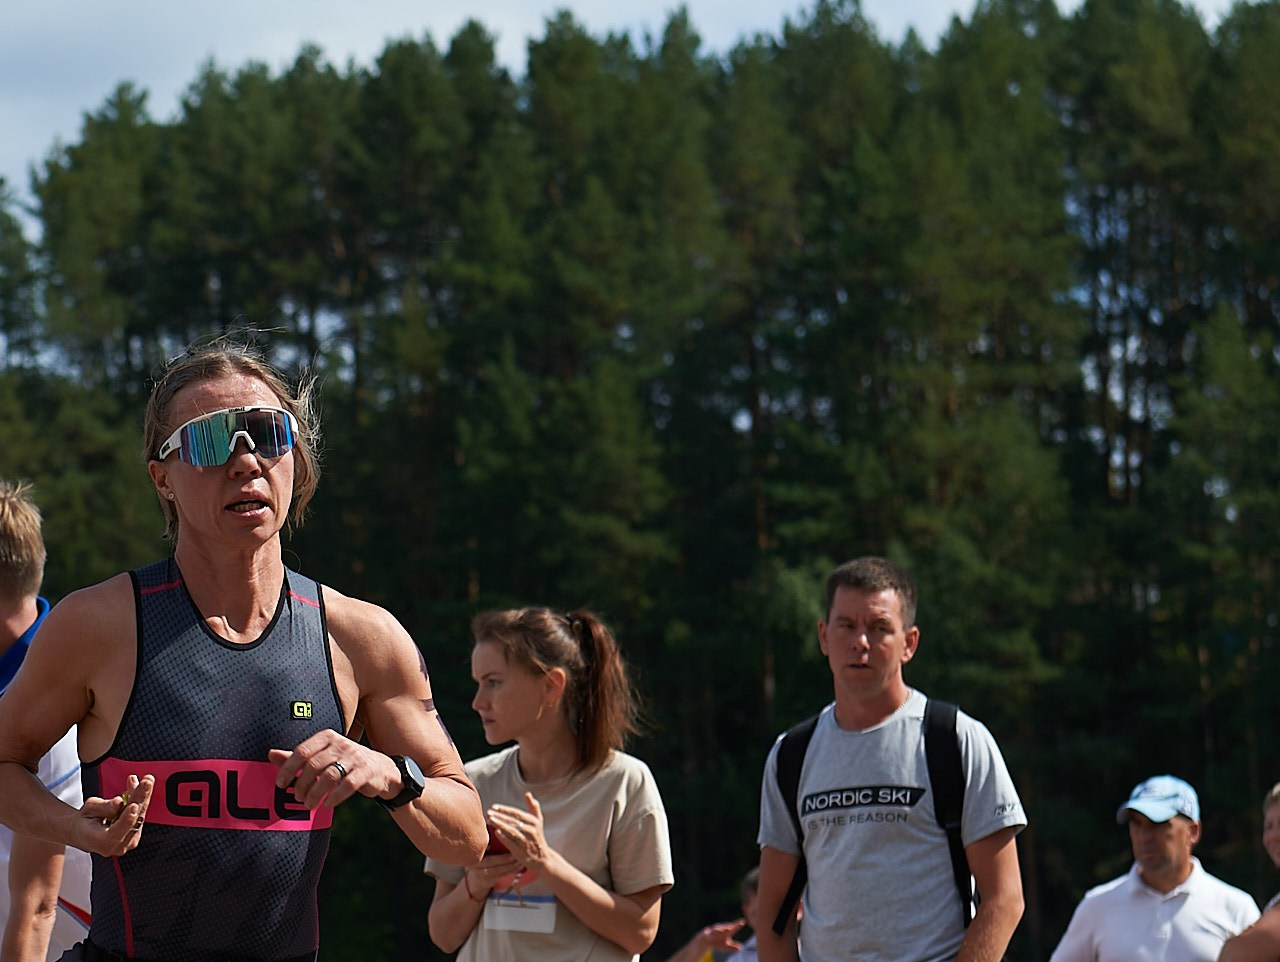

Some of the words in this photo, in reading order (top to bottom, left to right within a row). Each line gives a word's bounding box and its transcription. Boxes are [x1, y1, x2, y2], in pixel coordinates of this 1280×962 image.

[805, 789, 873, 812] NORDIC
[878, 788, 911, 804] SKI
[820, 815, 846, 828] THE
[848, 811, 908, 825] REASON
